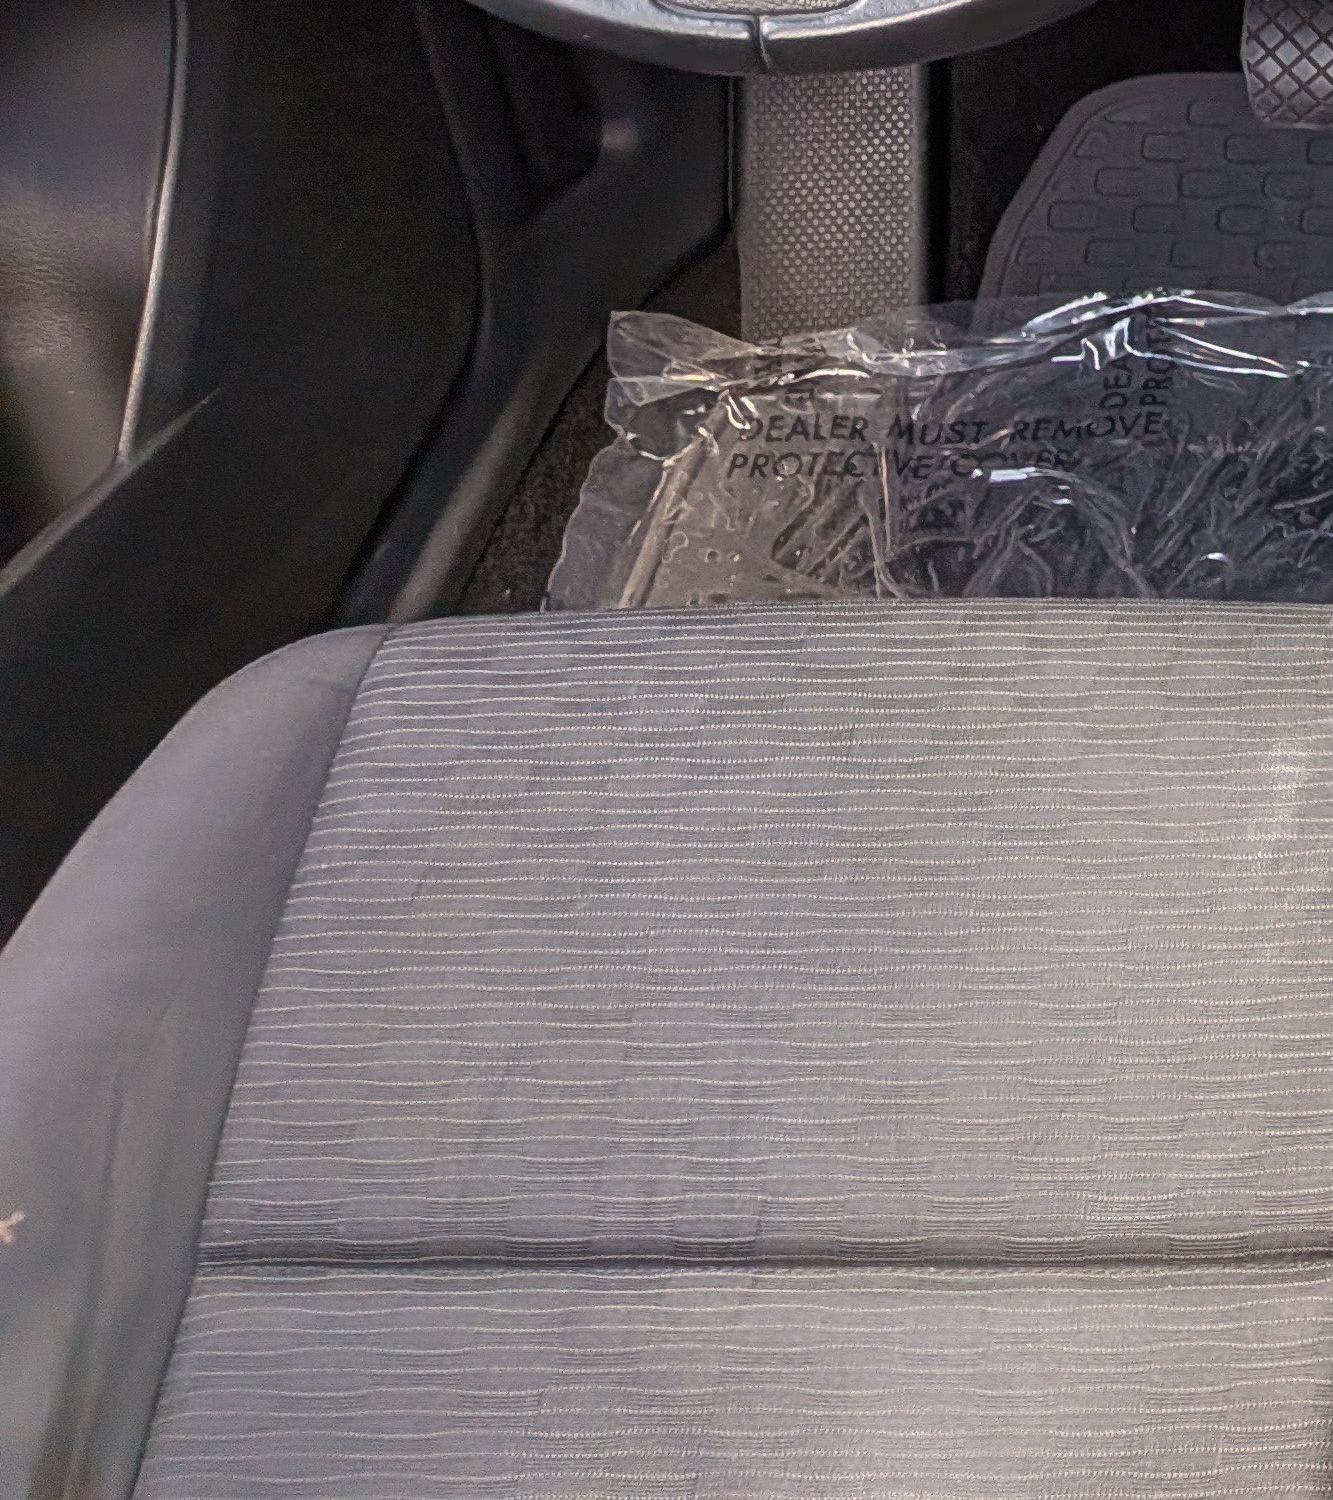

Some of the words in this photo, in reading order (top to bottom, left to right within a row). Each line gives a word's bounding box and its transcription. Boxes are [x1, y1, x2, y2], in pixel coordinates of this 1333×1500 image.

[737, 414, 870, 443] DEALER
[887, 414, 986, 447] MUST
[1008, 411, 1164, 444] REMOVE
